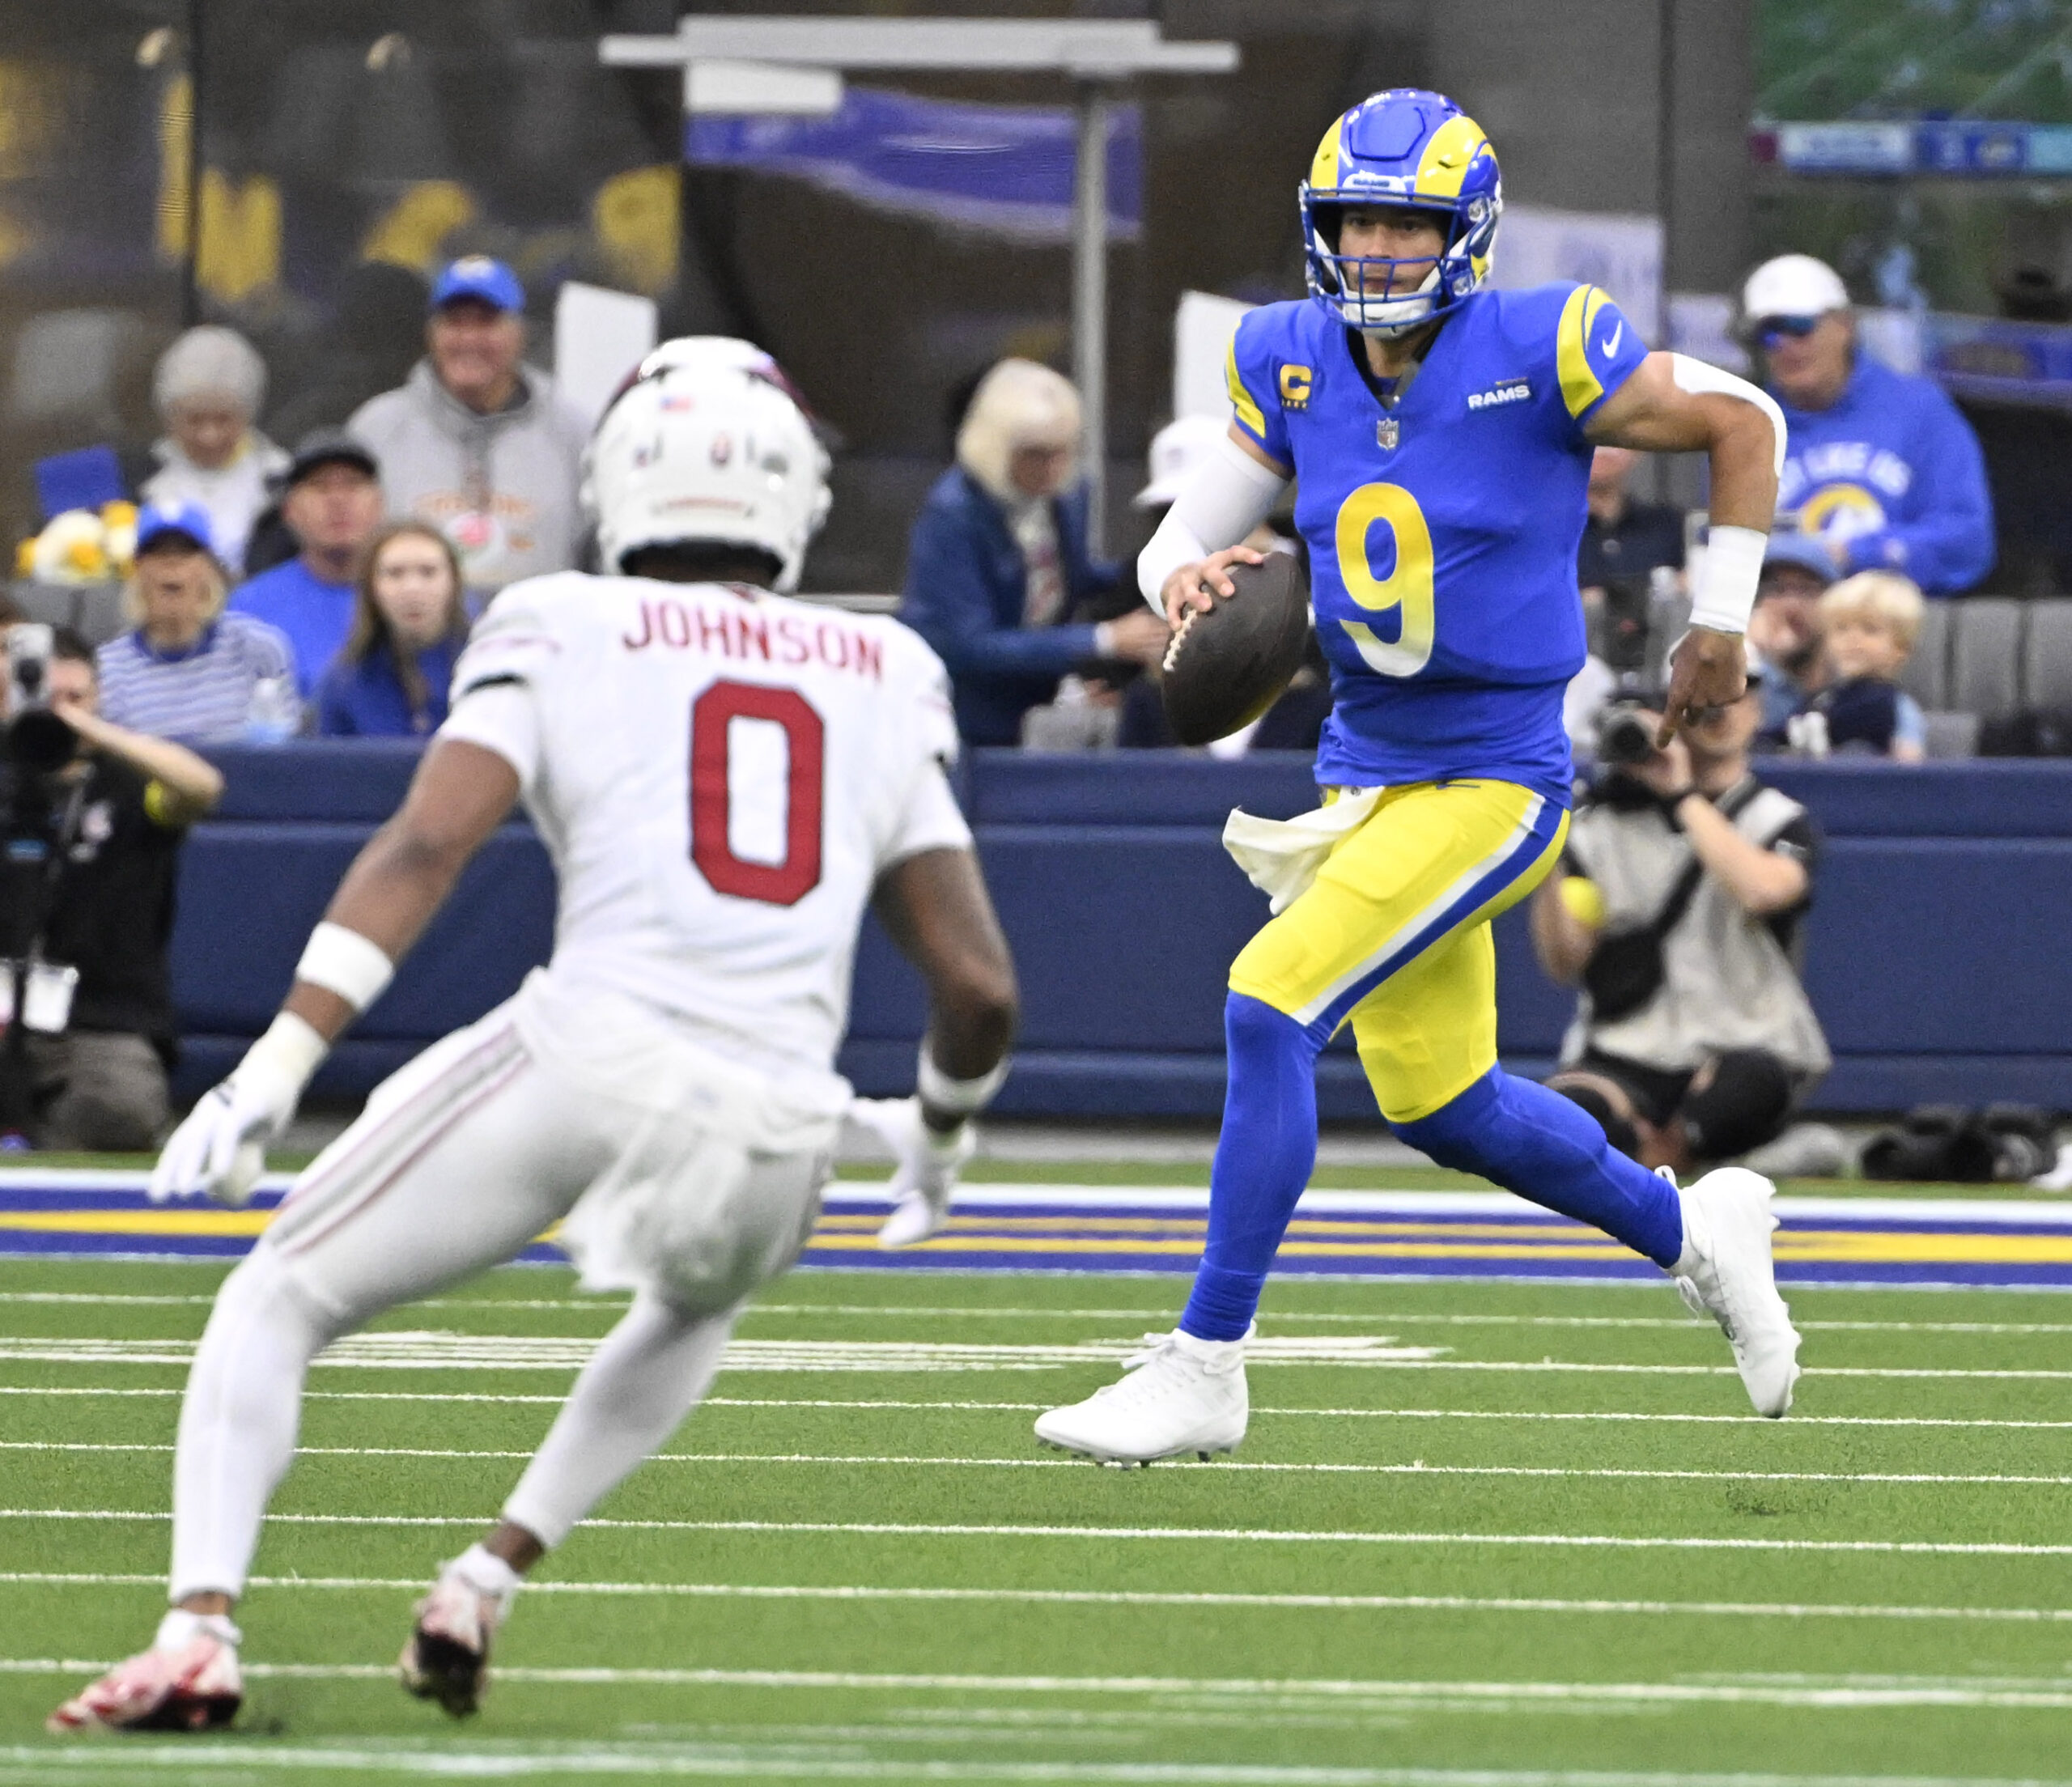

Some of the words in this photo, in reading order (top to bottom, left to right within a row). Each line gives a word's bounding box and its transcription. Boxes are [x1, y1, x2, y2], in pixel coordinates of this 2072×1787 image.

[1280, 363, 1311, 400] C
[1467, 384, 1530, 410] RAMS
[1335, 482, 1434, 678] 9
[622, 599, 884, 684] JOHNSON
[690, 677, 824, 906] 0
